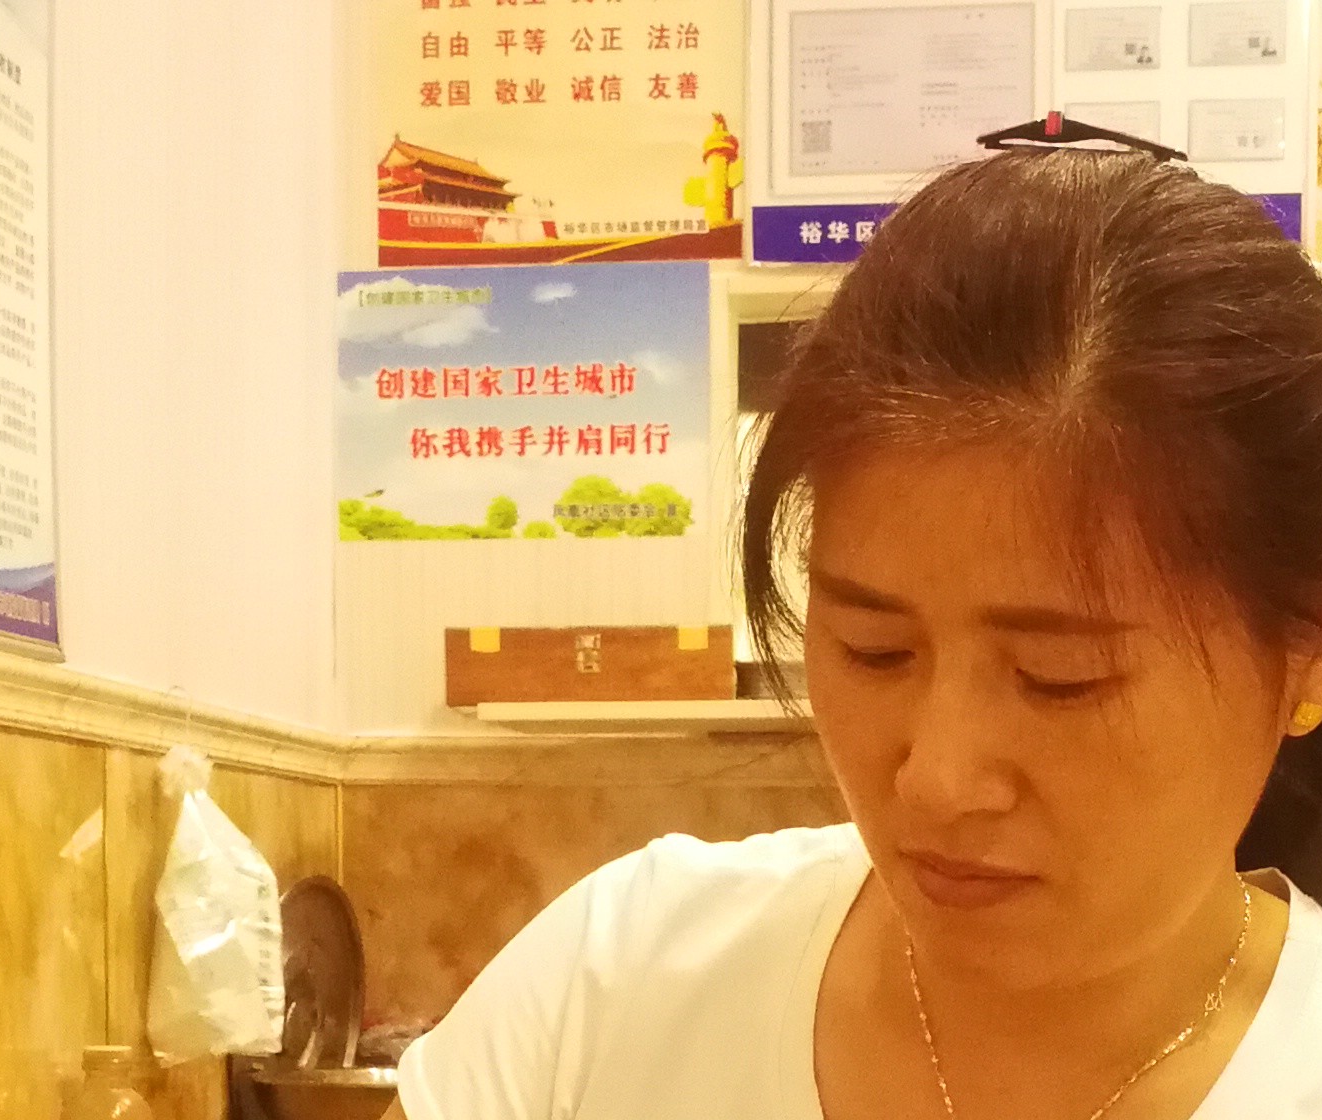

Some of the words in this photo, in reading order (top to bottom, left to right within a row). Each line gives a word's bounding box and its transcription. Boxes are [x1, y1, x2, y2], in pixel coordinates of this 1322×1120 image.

[422, 32, 469, 58] 自由
[495, 29, 547, 56] 平等
[571, 26, 623, 52] 公正
[648, 23, 700, 51] 法治
[420, 80, 471, 107] 爱国
[495, 78, 546, 104] 敬业
[571, 75, 623, 101] 诚信
[648, 72, 699, 99] 友善
[376, 363, 636, 399] 创建国家卫生城市
[410, 423, 670, 459] 你我携手并肩同行
